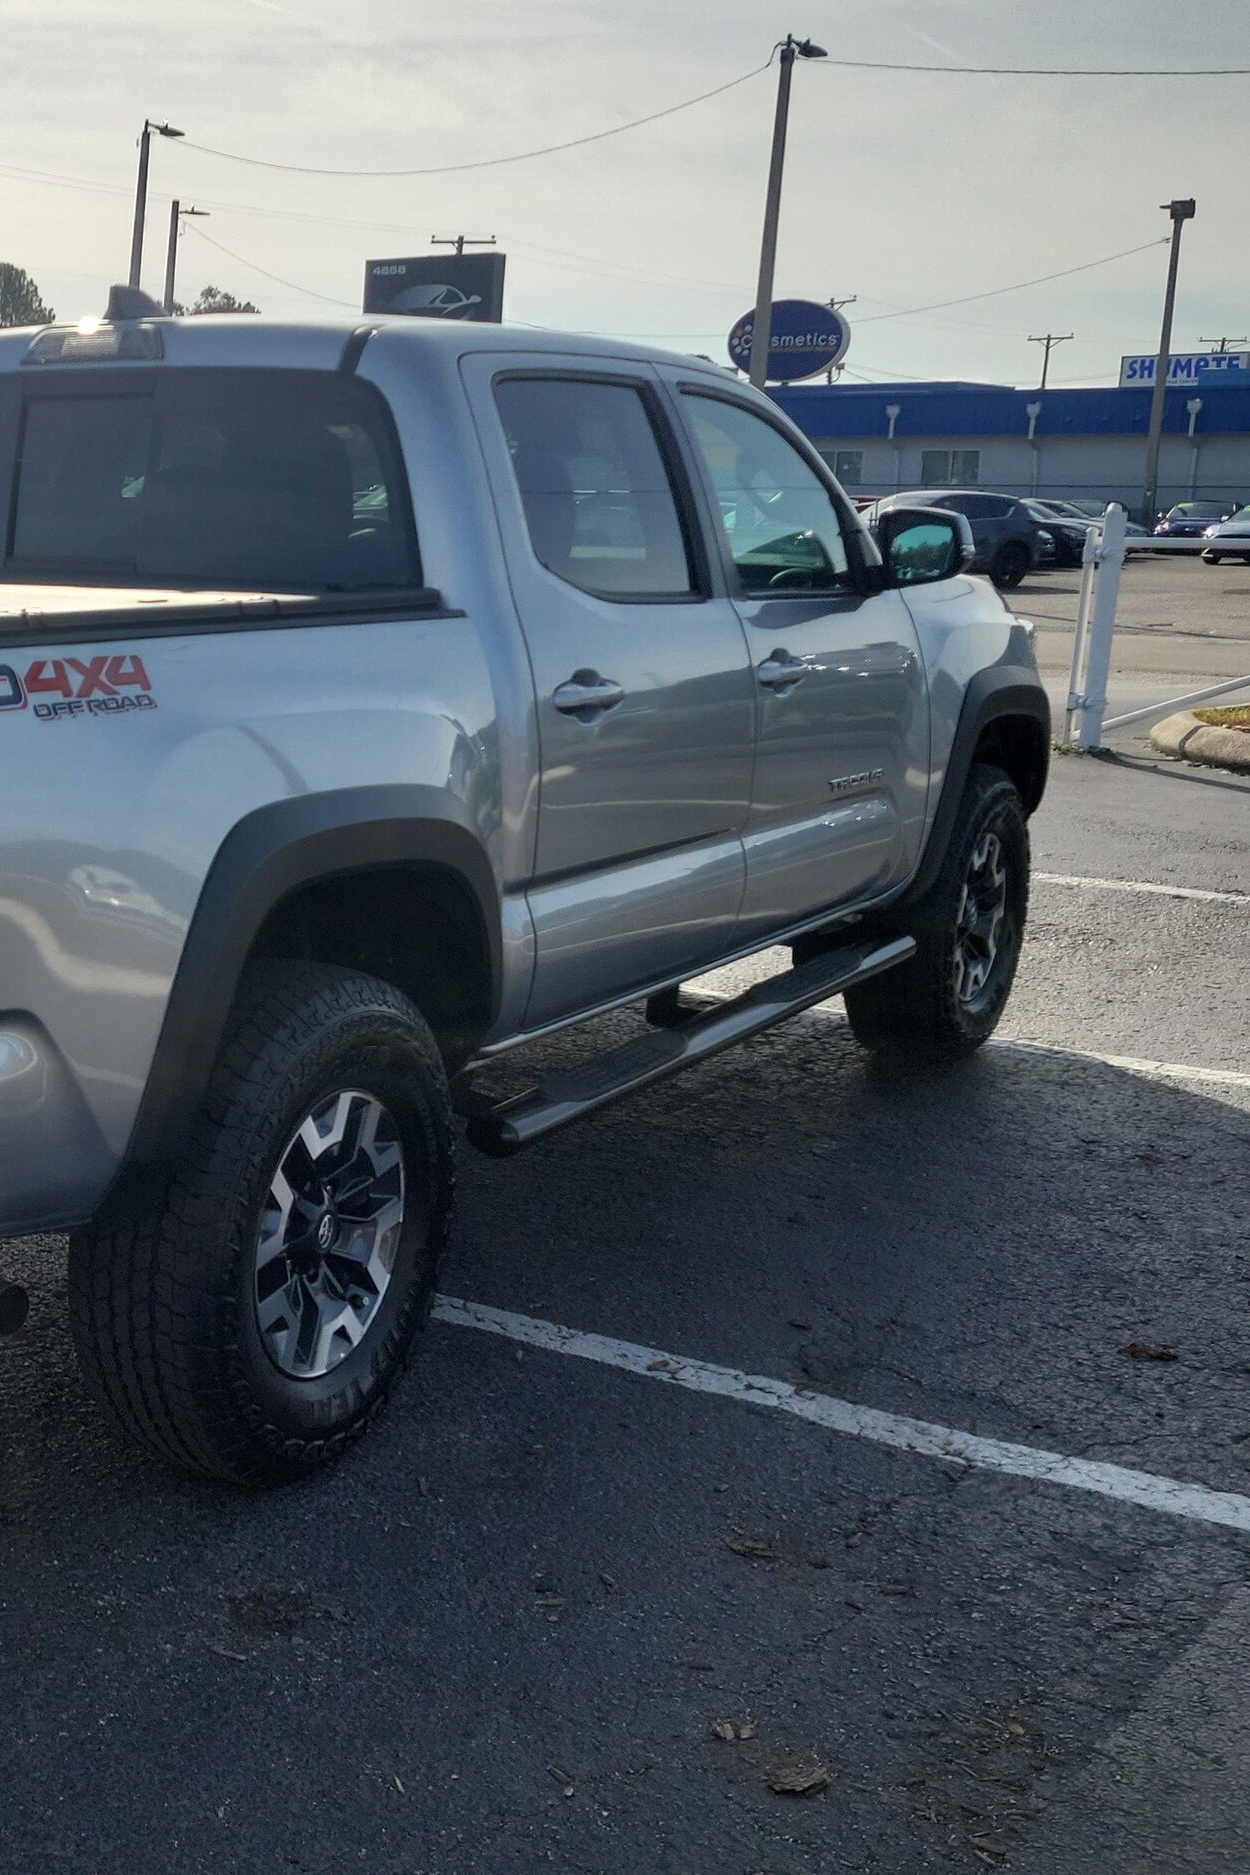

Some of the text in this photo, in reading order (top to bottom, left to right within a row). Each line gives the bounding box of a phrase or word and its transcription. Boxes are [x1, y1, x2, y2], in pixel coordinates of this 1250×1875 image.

[741, 333, 837, 348] Csmetics
[1126, 356, 1241, 379] SHMATE
[33, 694, 156, 721] OFF ROAD
